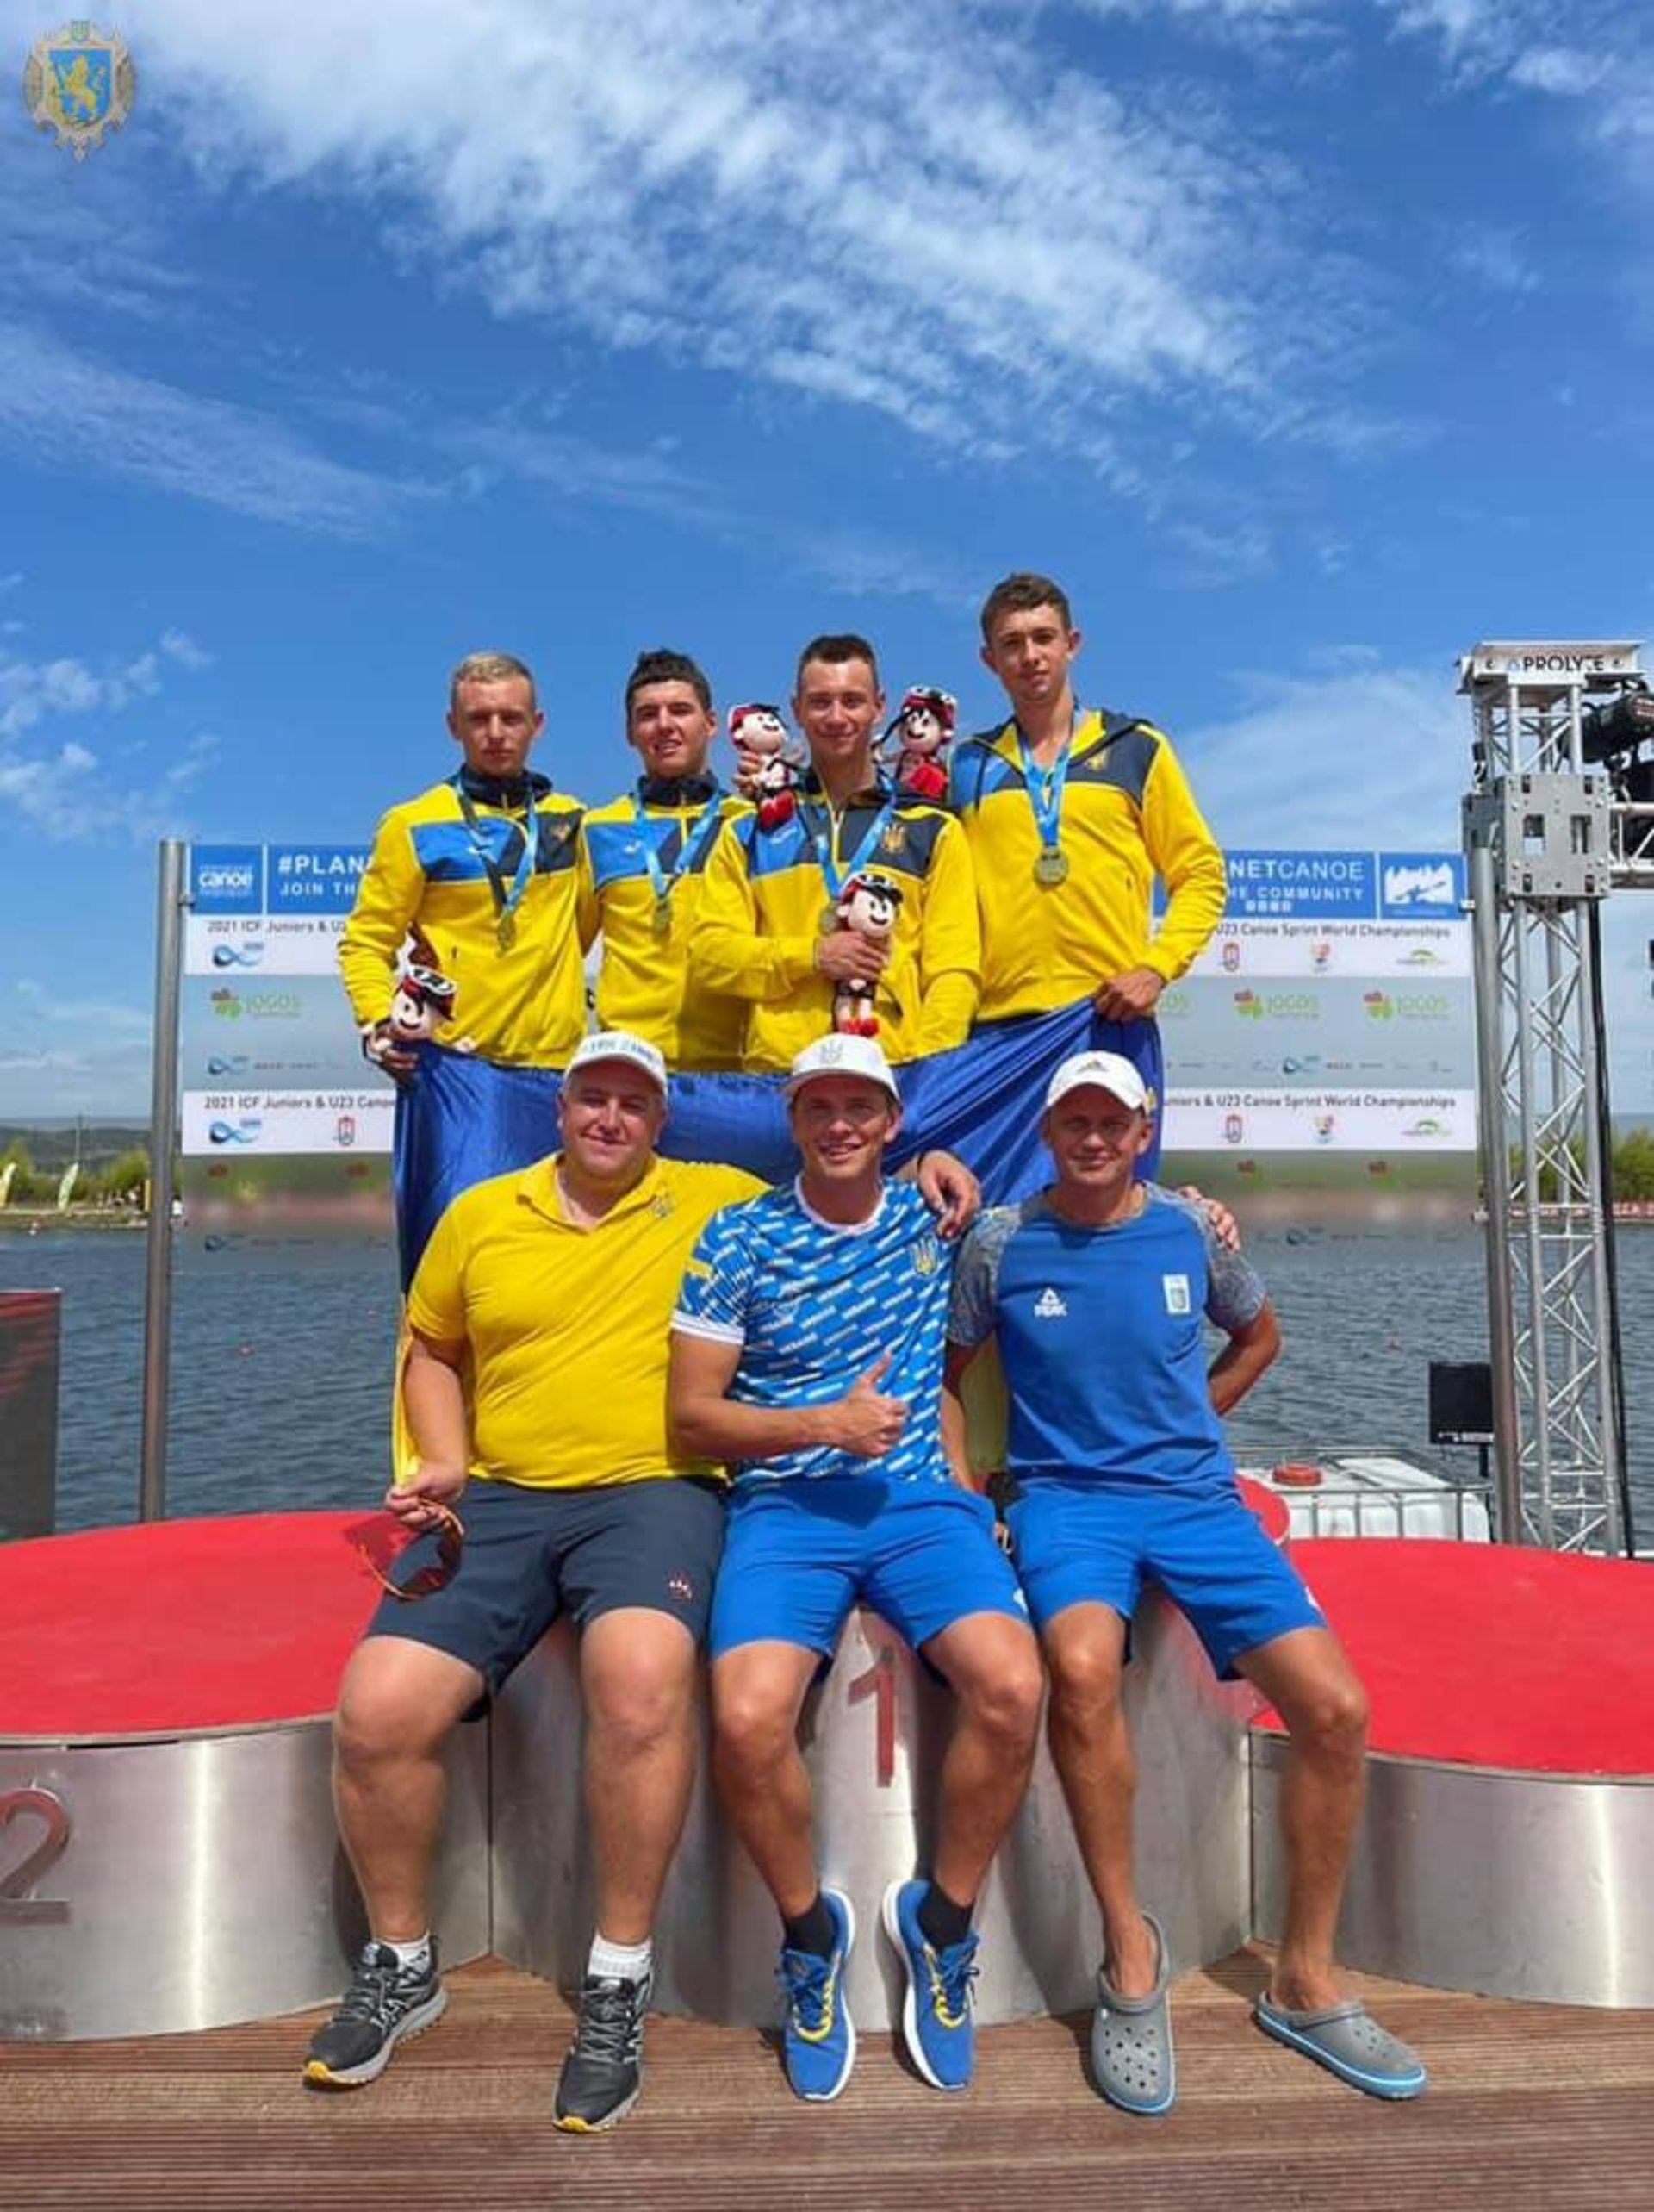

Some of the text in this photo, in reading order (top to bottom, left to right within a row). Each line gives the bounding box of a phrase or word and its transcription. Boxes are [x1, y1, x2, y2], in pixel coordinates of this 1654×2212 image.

[1229, 859, 1365, 881] NETCANOE
[281, 882, 324, 896] JOIN
[1257, 887, 1364, 901] COMMUNITY
[208, 921, 237, 933] 2021
[267, 921, 314, 934] Juniors
[318, 921, 327, 932] &
[1241, 923, 1278, 936] Canoe
[1282, 923, 1318, 938] Sprint
[1321, 924, 1358, 937] World
[1359, 924, 1451, 940] Championships
[204, 1096, 234, 1109] 2021
[239, 1096, 259, 1109] ICF
[263, 1096, 311, 1109] Juniors
[315, 1096, 326, 1109] &
[329, 1096, 354, 1109] U23
[1204, 1094, 1214, 1106] &
[1216, 1094, 1240, 1107] U23
[1244, 1094, 1282, 1107] Canoe
[1284, 1094, 1322, 1111] Sprint
[1325, 1094, 1361, 1107] World
[1363, 1094, 1456, 1111] Championships
[848, 1648, 895, 1788] 1
[0, 1788, 72, 1925] 2
